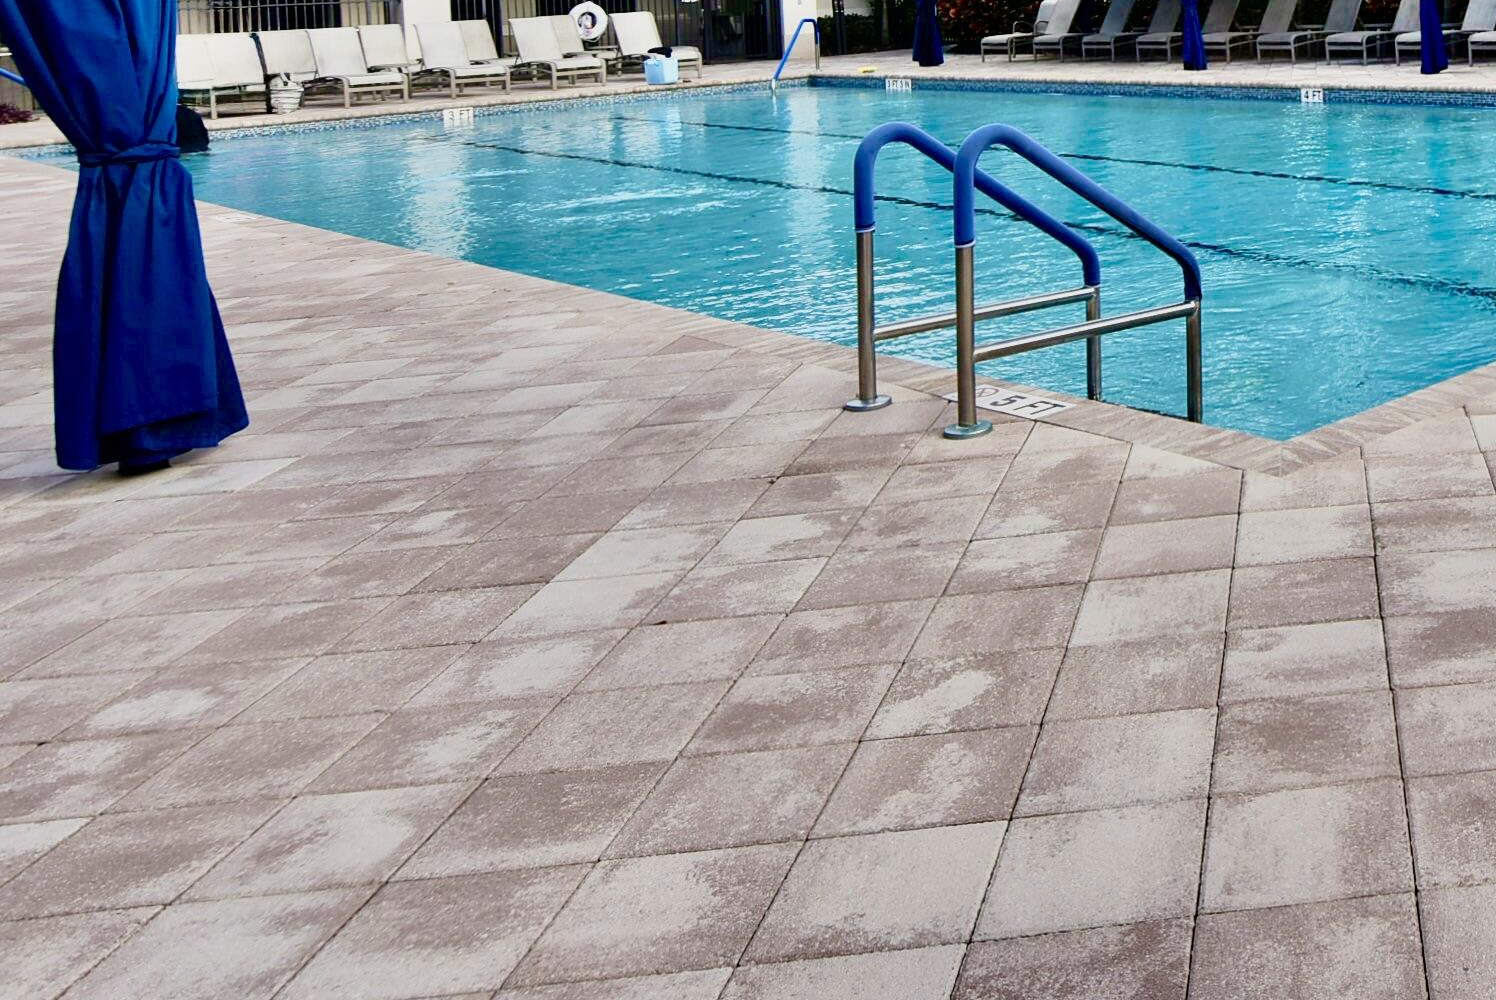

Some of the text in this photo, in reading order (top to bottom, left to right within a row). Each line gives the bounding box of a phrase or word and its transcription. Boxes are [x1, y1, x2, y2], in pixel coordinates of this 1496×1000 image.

[1303, 90, 1321, 100] 4 FT
[448, 109, 471, 121] 3 FT
[990, 394, 1067, 416] 5 FT
